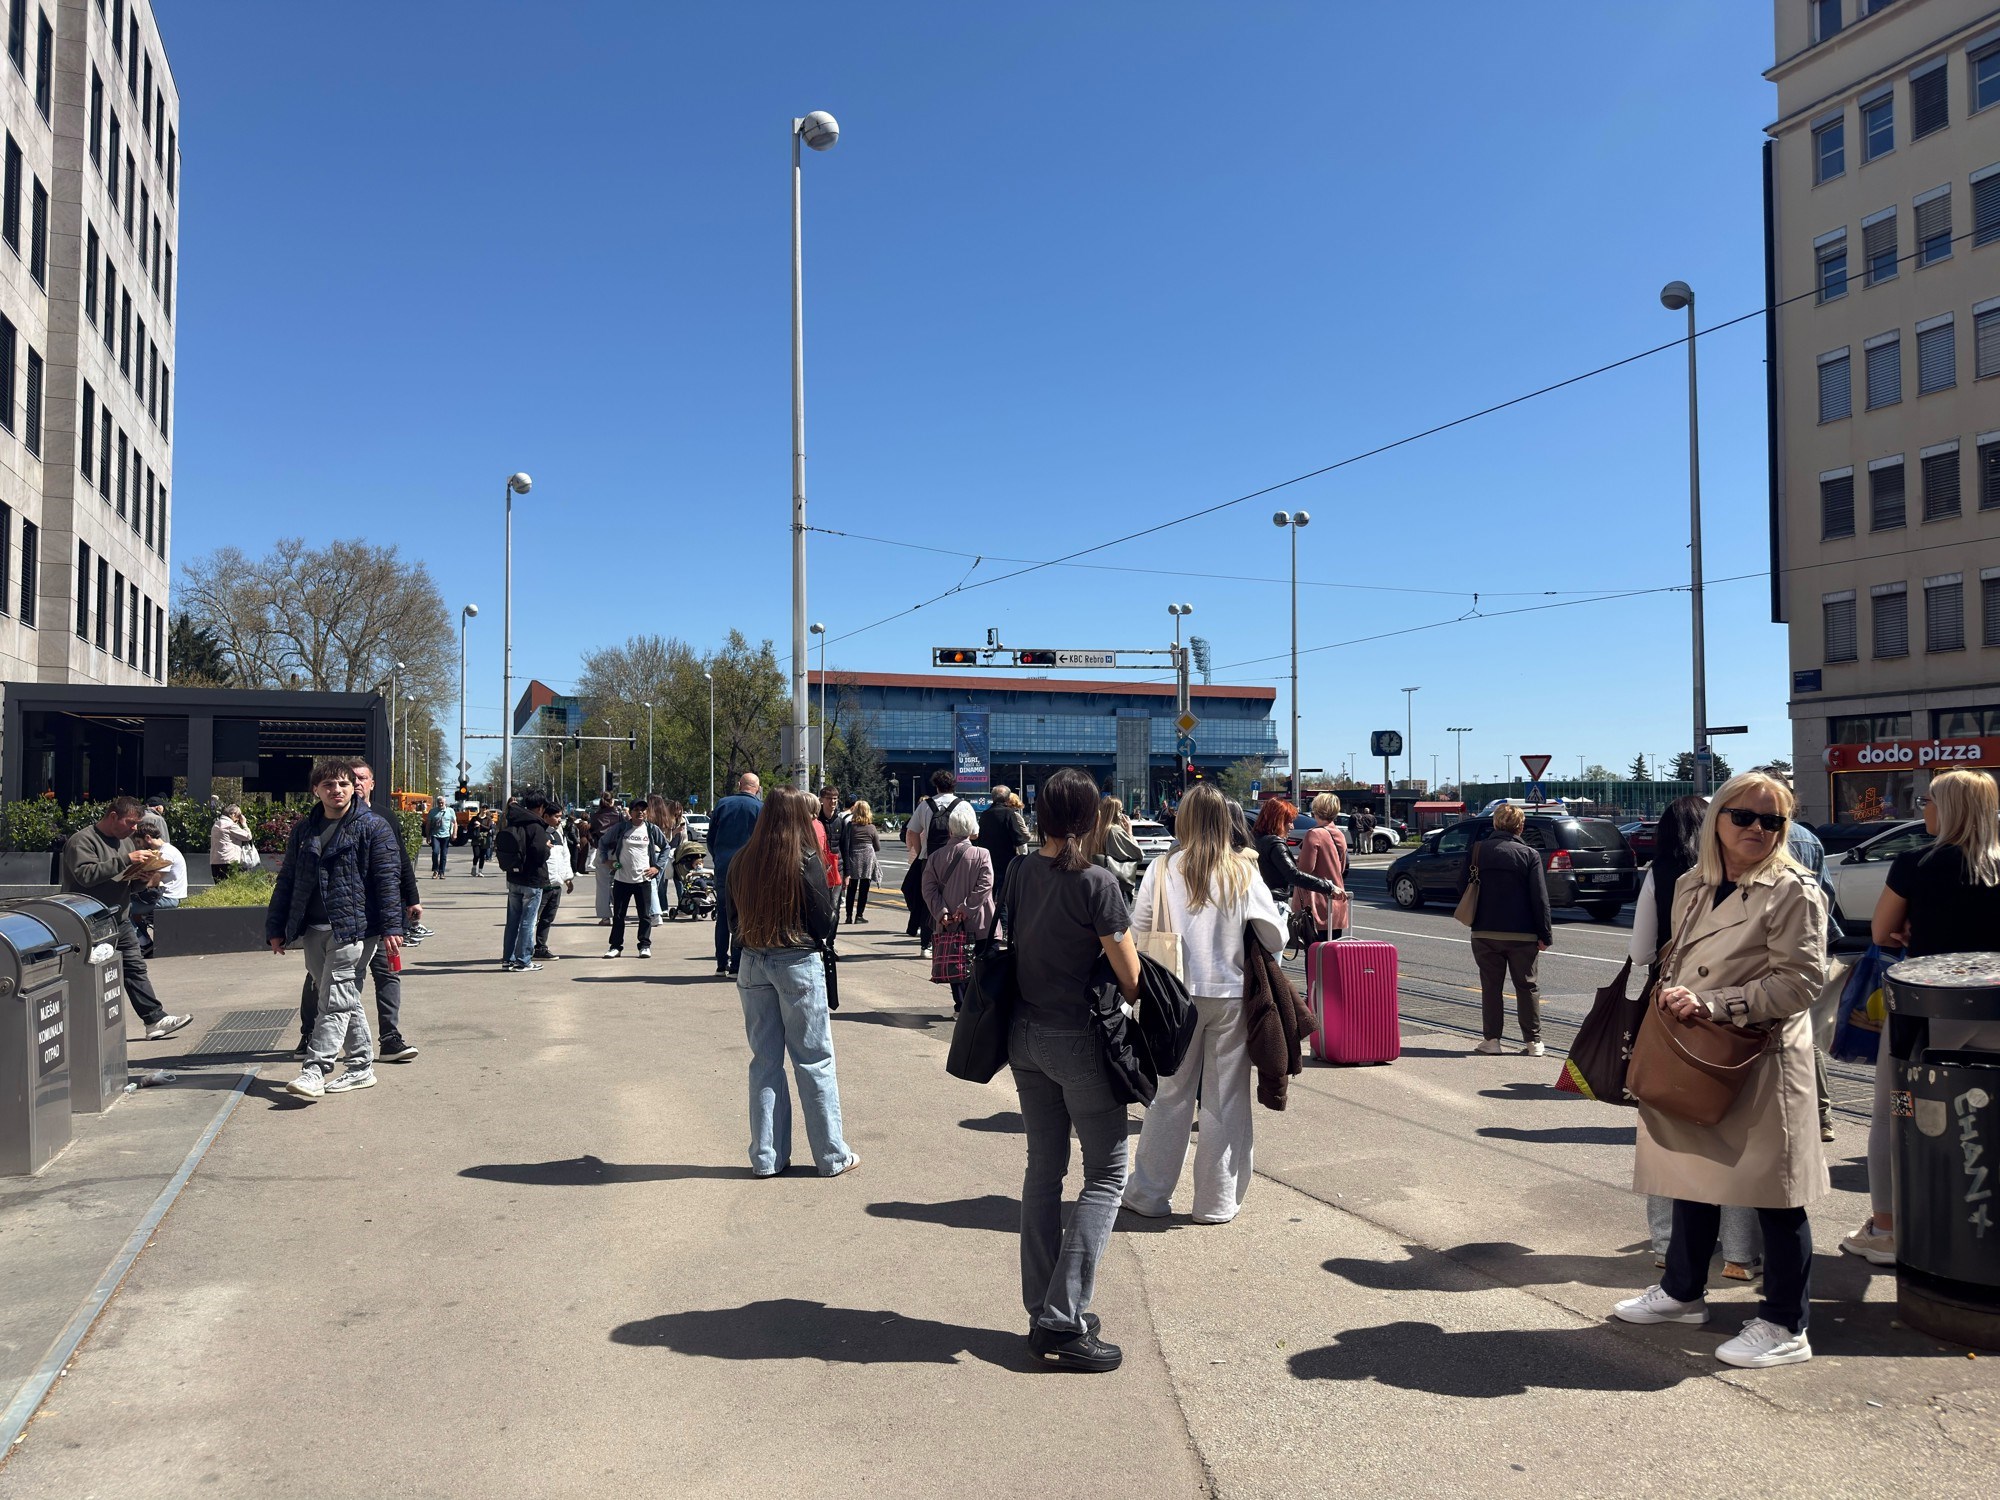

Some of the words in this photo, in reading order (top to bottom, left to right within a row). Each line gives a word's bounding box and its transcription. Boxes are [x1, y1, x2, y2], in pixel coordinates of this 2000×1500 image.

[1070, 655, 1082, 663] KBC
[1085, 655, 1104, 663] Rebro
[1857, 743, 1913, 764] dodo
[1919, 740, 1981, 766] pizza
[45, 1044, 60, 1063] OTPAD
